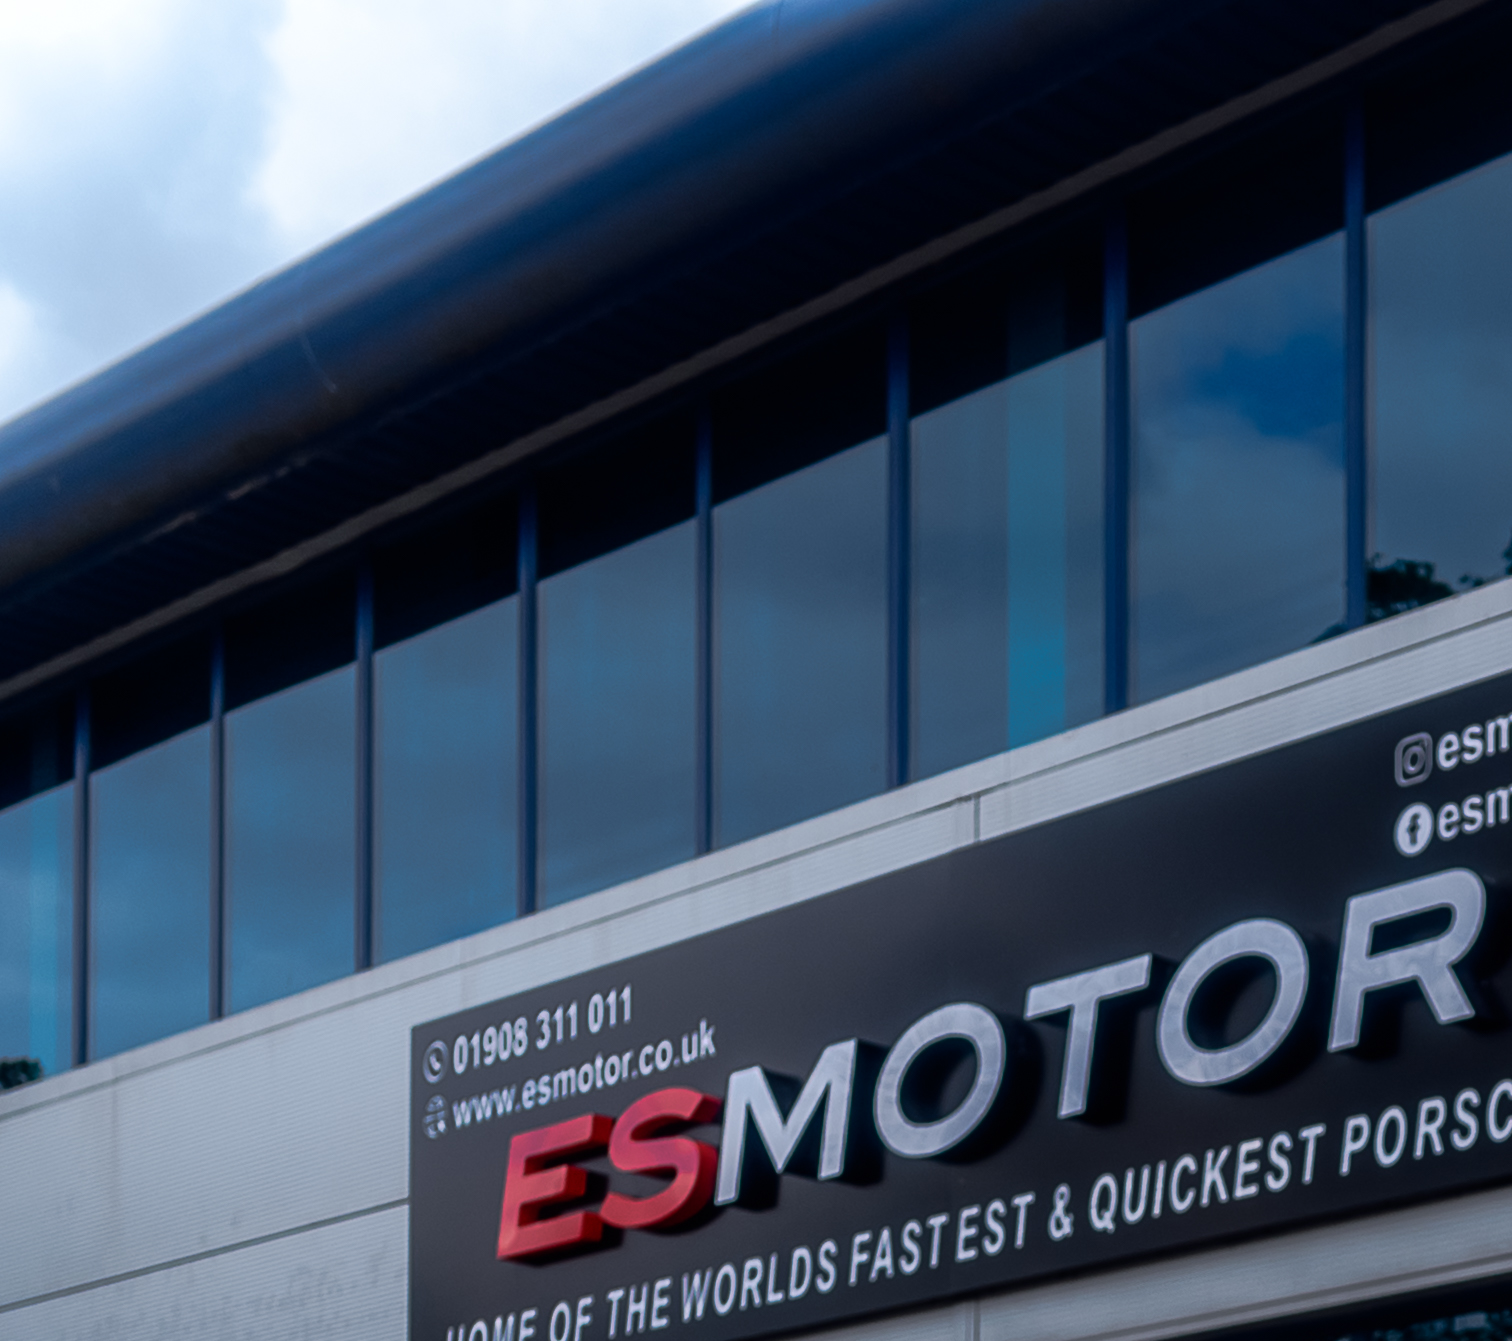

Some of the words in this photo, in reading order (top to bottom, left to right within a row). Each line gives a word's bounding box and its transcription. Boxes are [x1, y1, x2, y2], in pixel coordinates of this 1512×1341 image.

[452, 1018, 716, 1129] www.esmotor.co.uk
[453, 1016, 528, 1074] 01908
[536, 1001, 578, 1051] 311
[588, 984, 632, 1034] 011
[497, 868, 1486, 1260] ESMOTOR
[606, 1277, 671, 1340] THE
[680, 1238, 840, 1322] WORLDS
[848, 1192, 1035, 1287] FASTEST
[1048, 1184, 1075, 1241] &
[1089, 1123, 1327, 1234] QUICKEST
